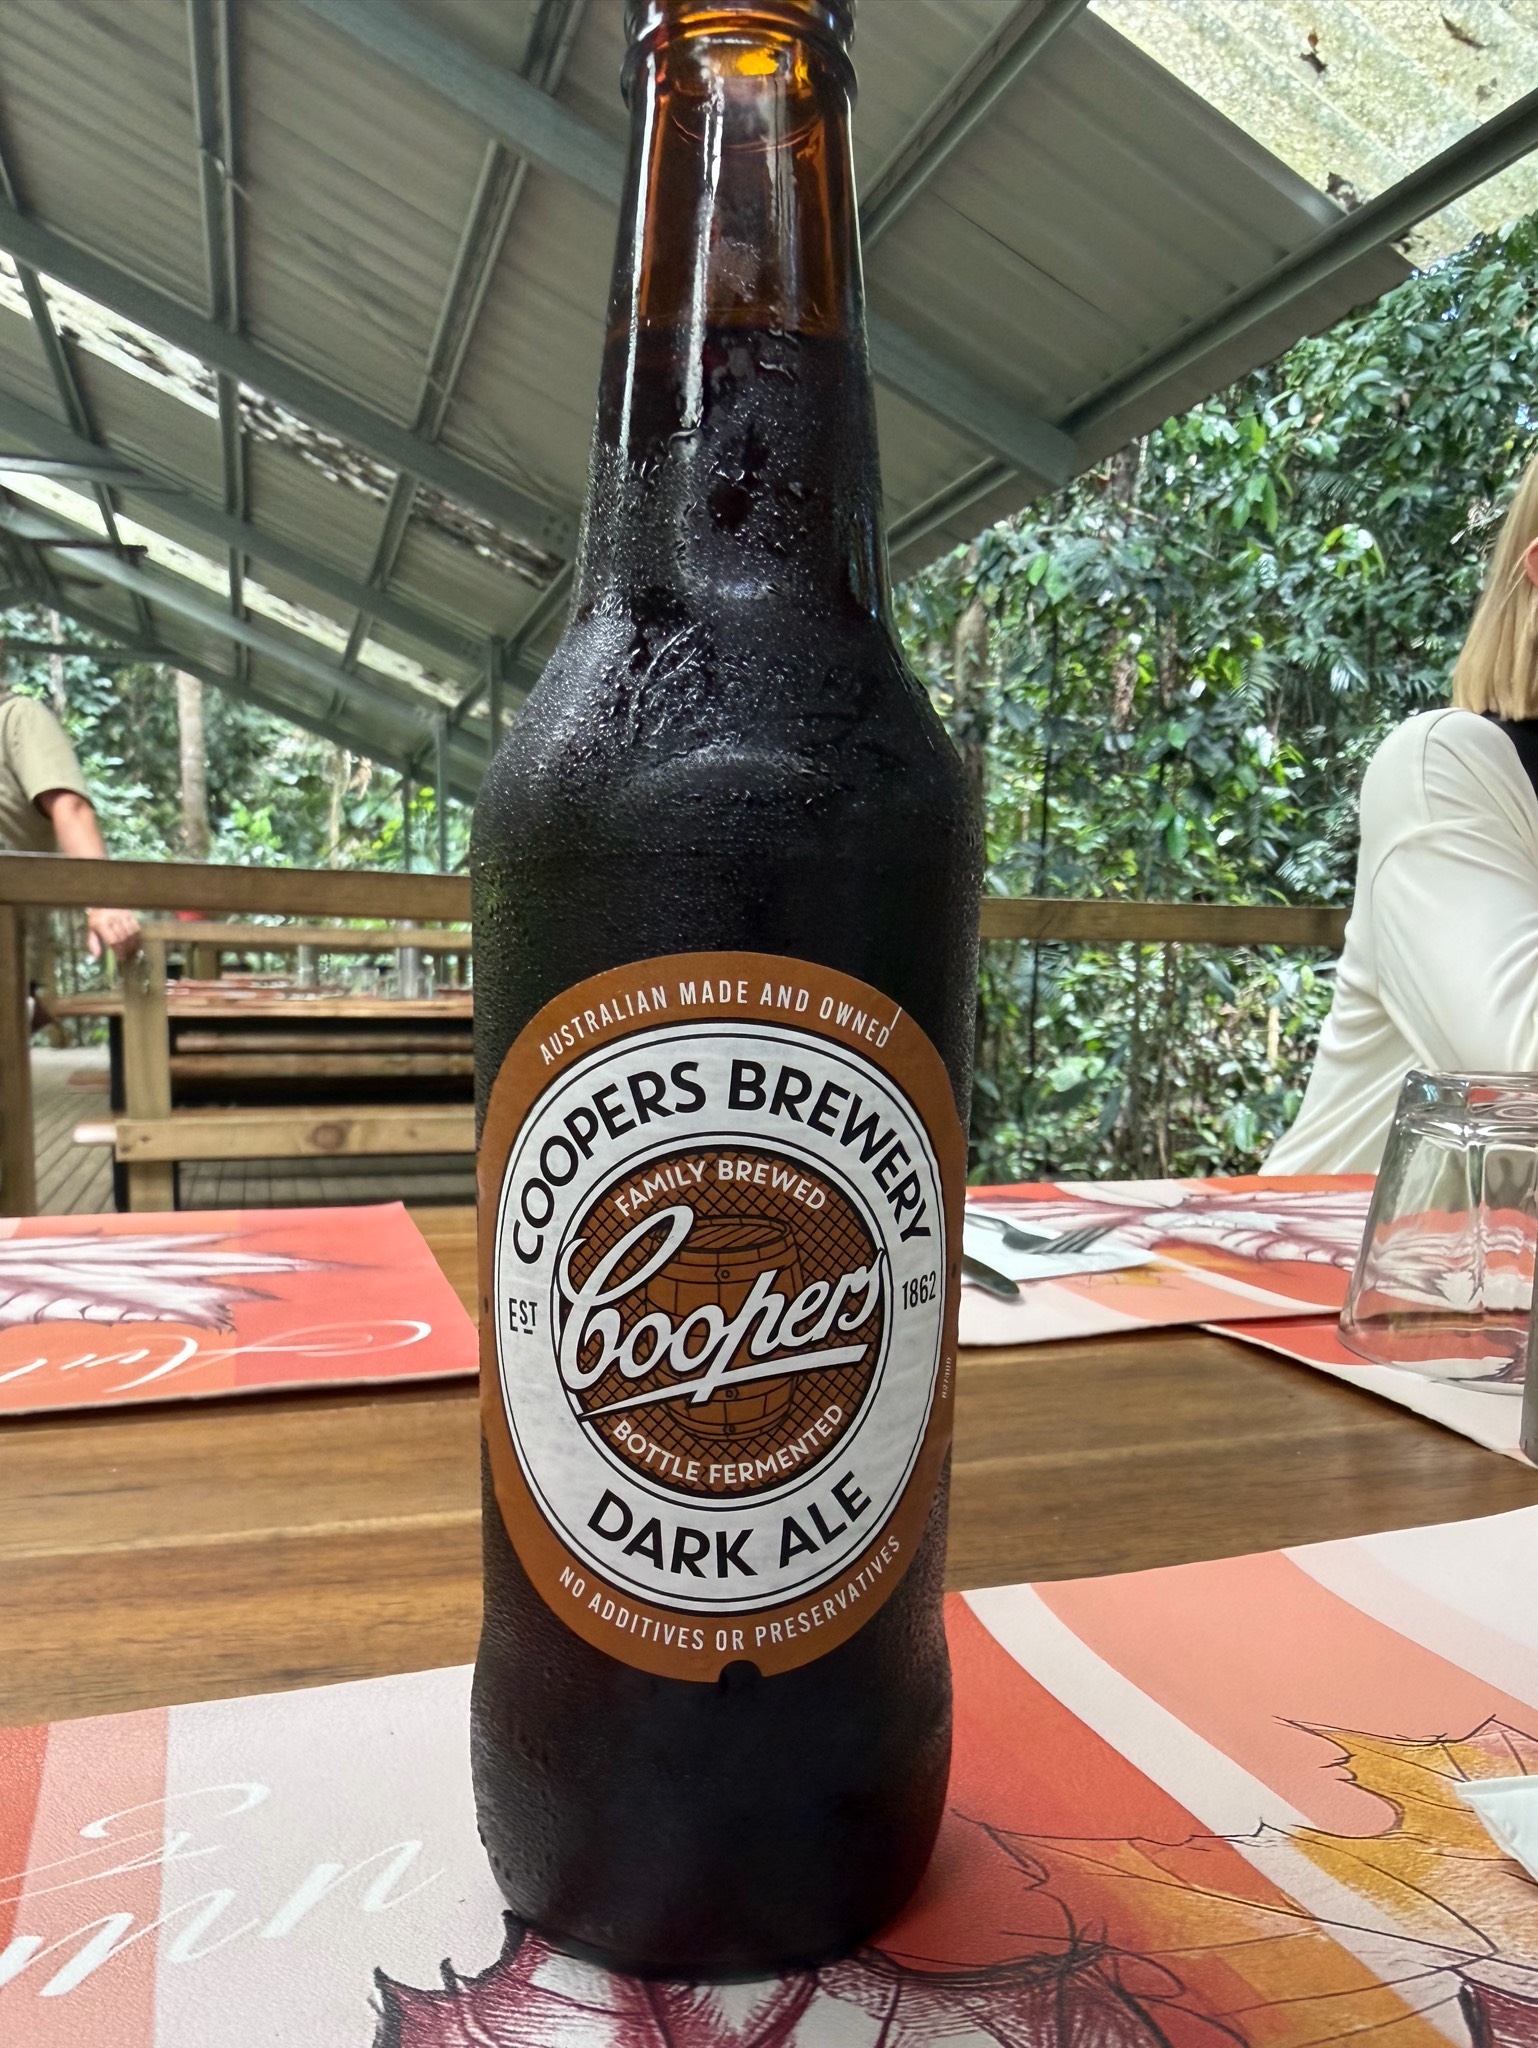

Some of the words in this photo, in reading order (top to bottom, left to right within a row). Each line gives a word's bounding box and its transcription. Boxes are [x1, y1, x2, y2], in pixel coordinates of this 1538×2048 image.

[539, 985, 668, 1066] AUSTRALIAN
[679, 979, 749, 1006] MADE
[759, 982, 809, 1013] AND
[819, 995, 891, 1049] OWNED
[512, 1060, 707, 1265] COOPERS
[727, 1059, 932, 1244] BREWERY
[614, 1158, 706, 1218] FAMILY
[717, 1160, 827, 1211] BREWED
[508, 1298, 539, 1335] EST
[556, 1204, 888, 1404] Coopers
[902, 1270, 937, 1311] 1862
[611, 1419, 699, 1482] BOTTLE
[709, 1403, 843, 1485] FERMENTED
[586, 1488, 759, 1579] DARK
[778, 1470, 872, 1569] ALE
[558, 1565, 585, 1599] NO
[588, 1592, 705, 1651] ADDITIVES
[715, 1629, 745, 1651] OR
[755, 1535, 901, 1648] PRESERVATIVES
